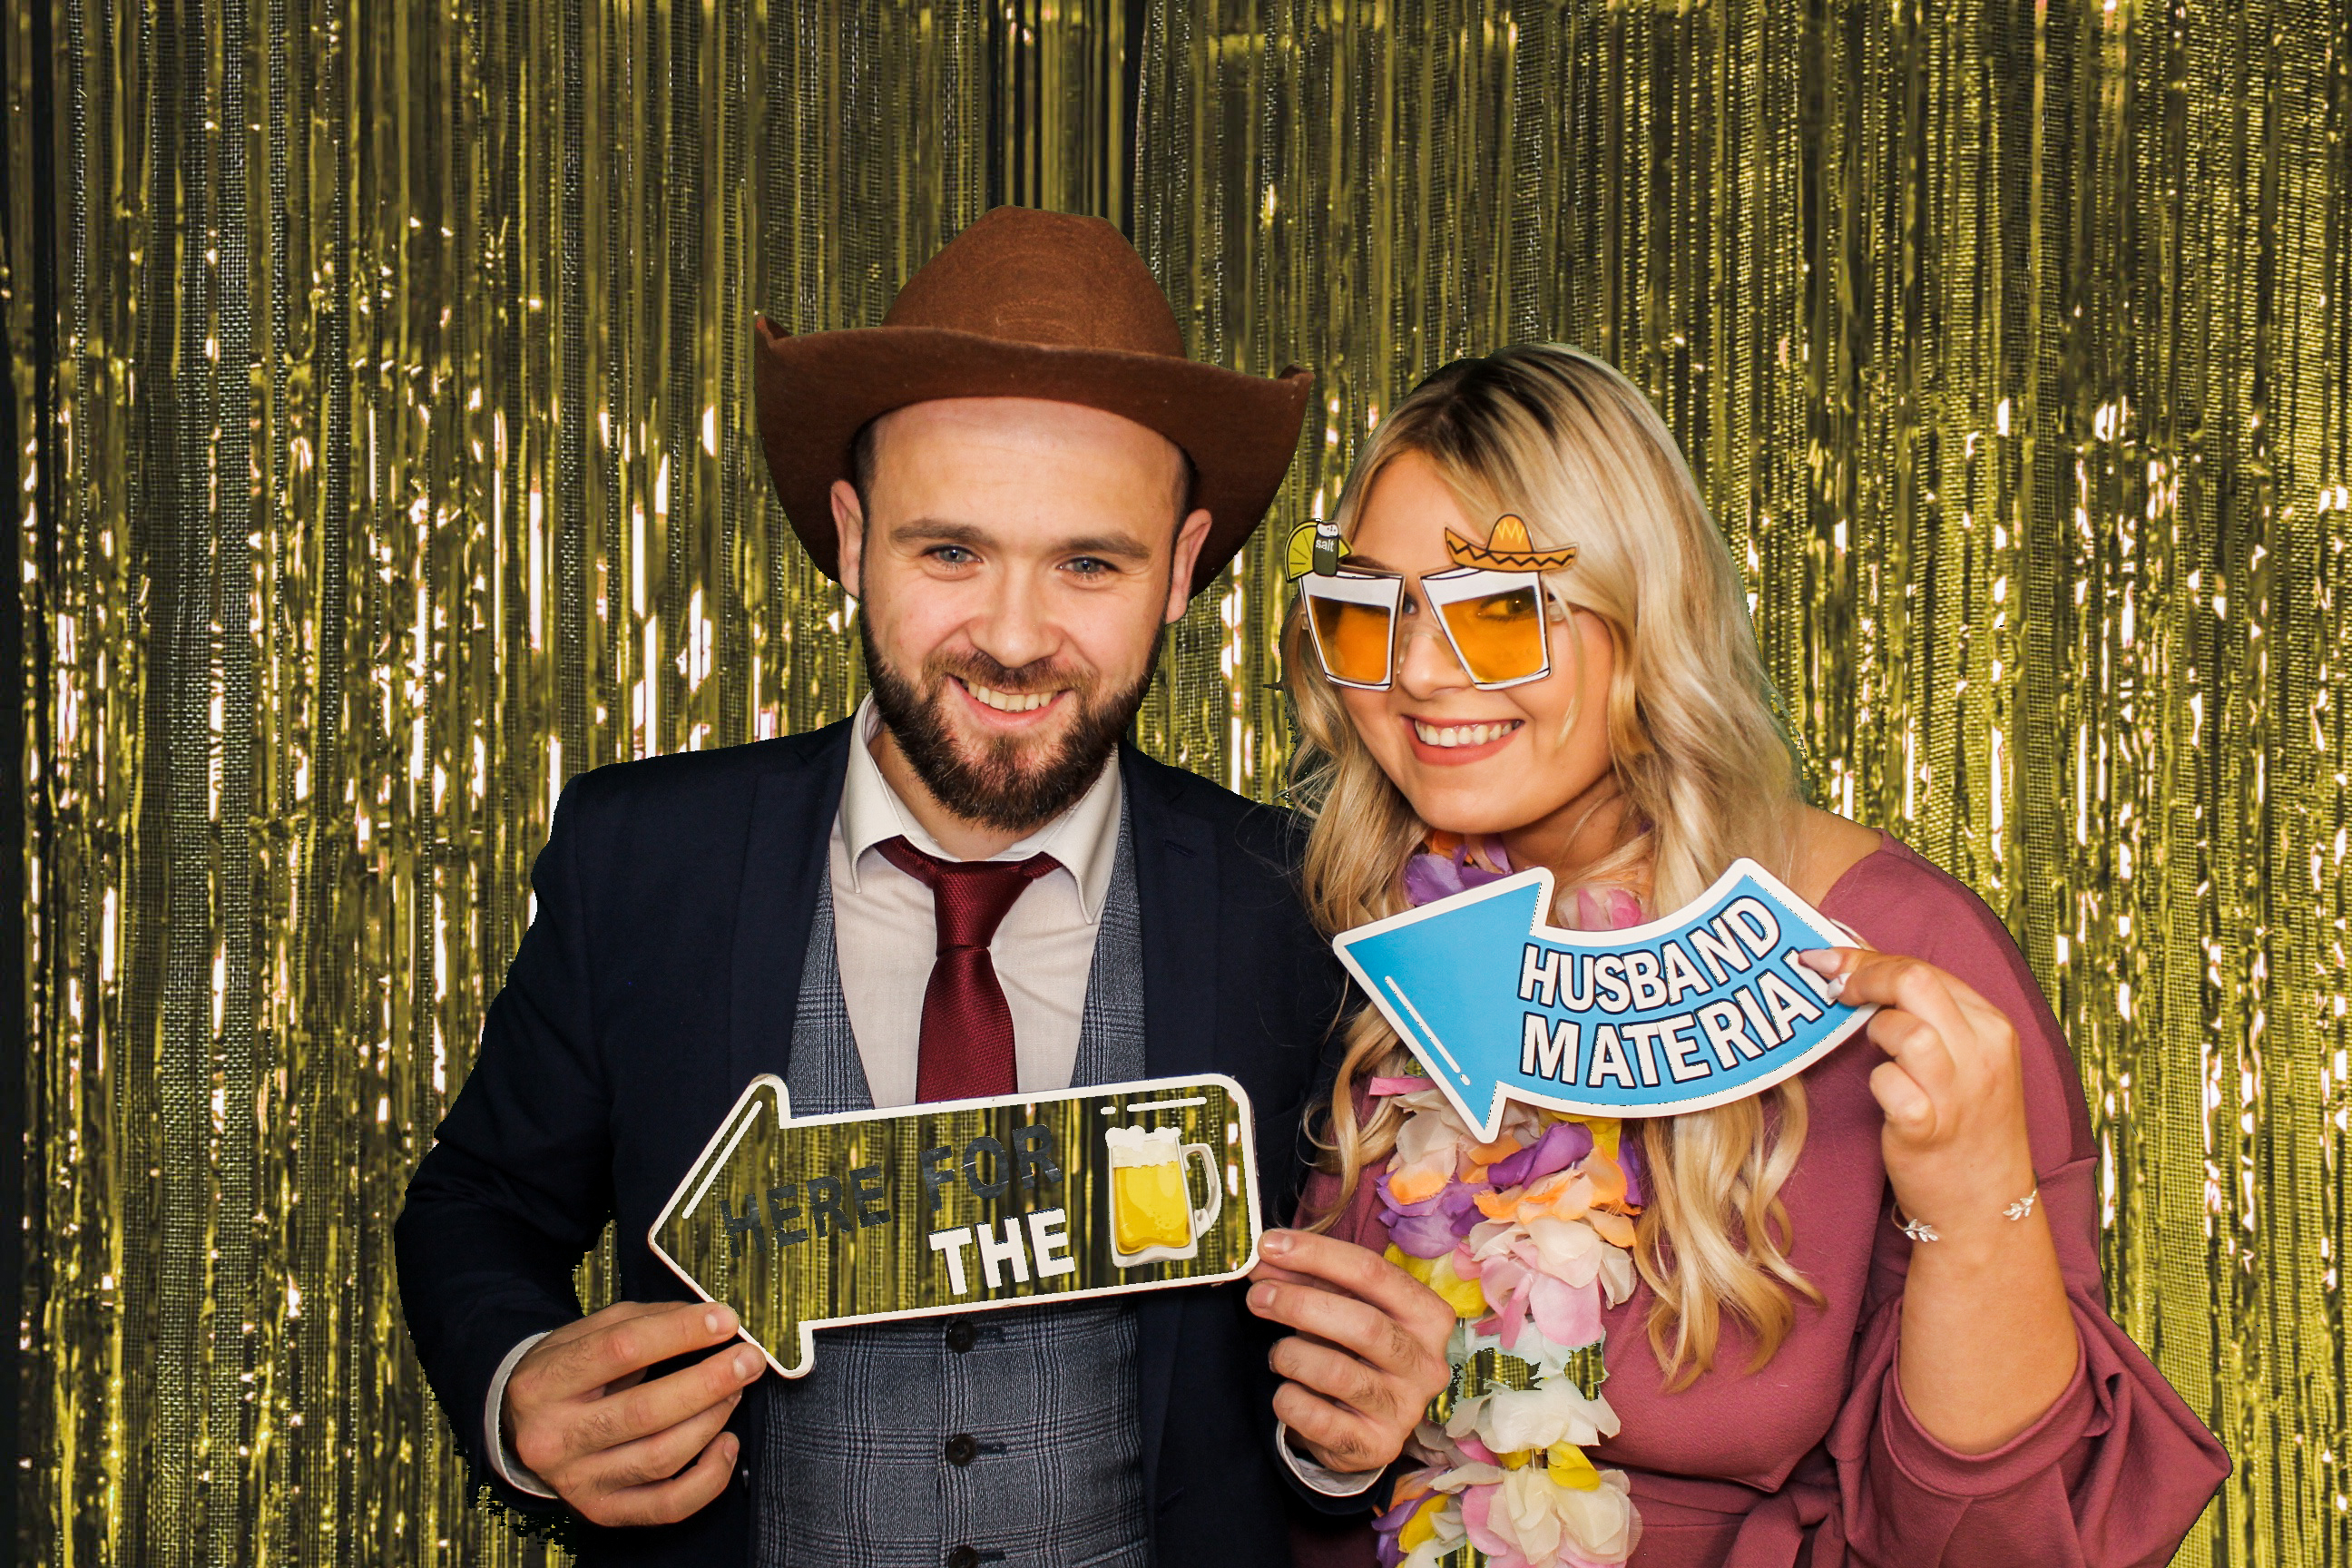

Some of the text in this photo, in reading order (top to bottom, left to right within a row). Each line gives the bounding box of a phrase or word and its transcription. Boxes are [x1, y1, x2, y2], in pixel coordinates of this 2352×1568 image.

[1315, 538, 1334, 553] salt
[1518, 895, 1780, 1014] HUSBAND
[720, 1124, 1063, 1258] HERE FOR
[927, 1208, 1076, 1295] THE
